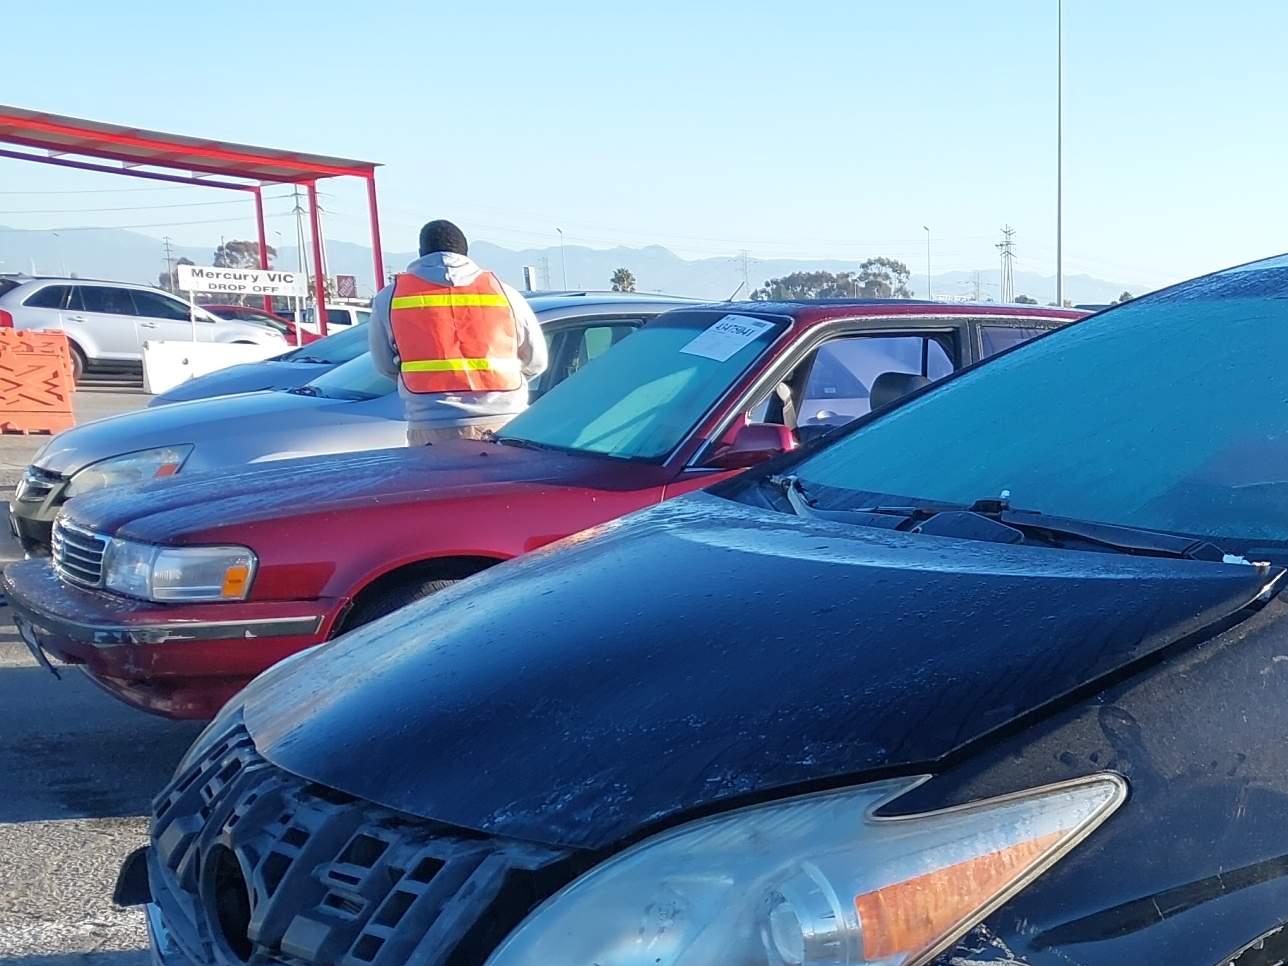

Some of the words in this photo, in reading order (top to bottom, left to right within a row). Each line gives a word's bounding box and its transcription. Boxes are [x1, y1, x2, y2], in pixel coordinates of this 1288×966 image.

[191, 268, 260, 282] Mercury
[266, 272, 294, 284] VIC
[208, 282, 246, 292] DROP
[252, 285, 279, 293] OFF
